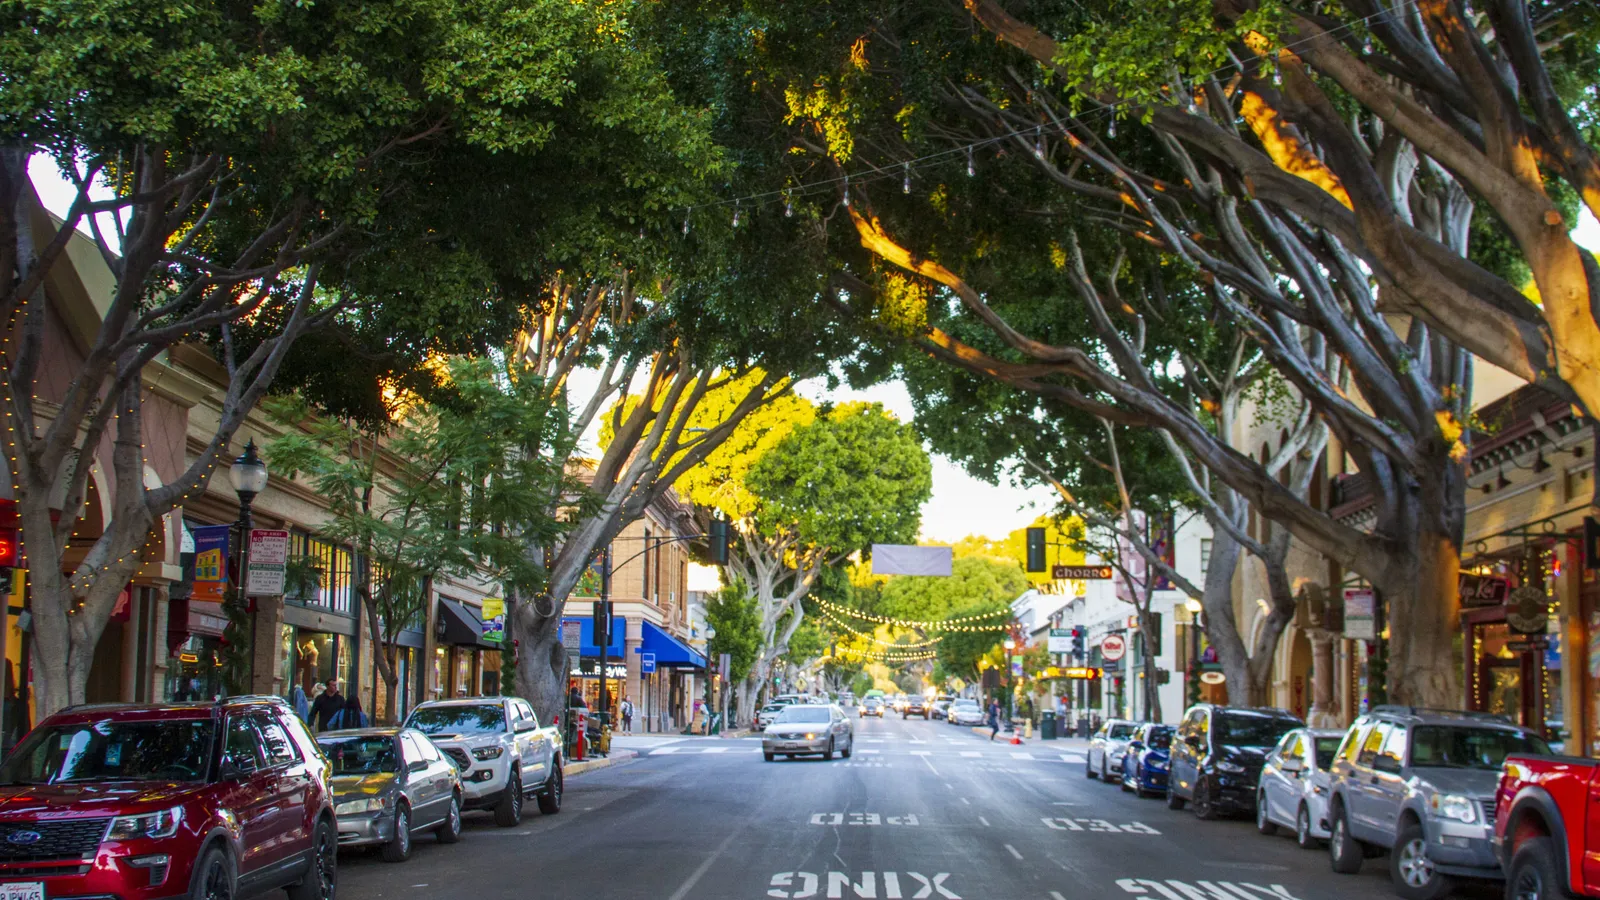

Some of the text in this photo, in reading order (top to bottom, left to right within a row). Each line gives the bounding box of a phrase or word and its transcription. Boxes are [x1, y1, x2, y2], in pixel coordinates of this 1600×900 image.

[810, 812, 920, 826] PED
[1041, 817, 1163, 835] PED
[767, 871, 963, 900] XING
